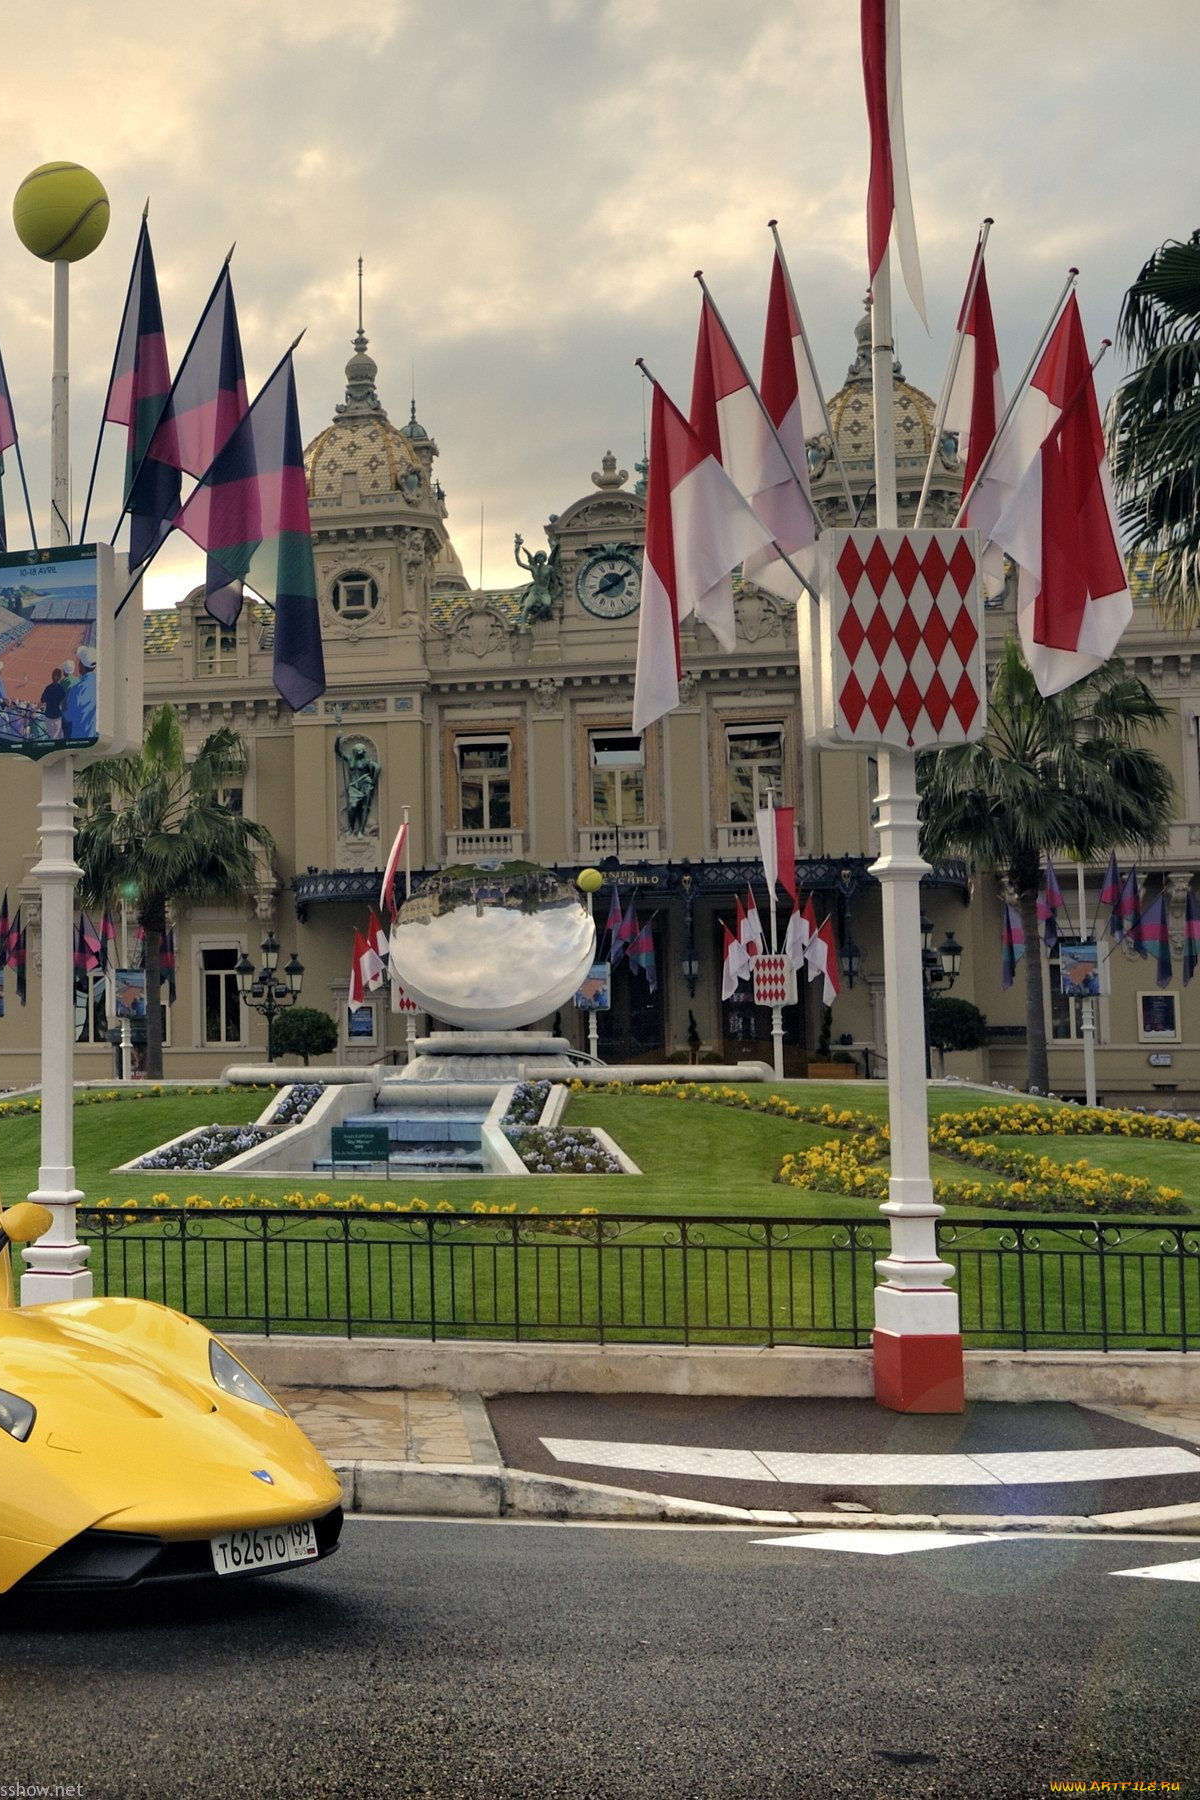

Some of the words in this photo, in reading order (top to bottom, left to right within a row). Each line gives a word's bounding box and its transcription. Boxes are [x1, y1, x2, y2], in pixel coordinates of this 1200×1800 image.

[38, 566, 57, 576] AVRIL
[218, 1530, 287, 1569] T626TO
[287, 1521, 310, 1546] 199
[295, 1546, 307, 1556] RUS
